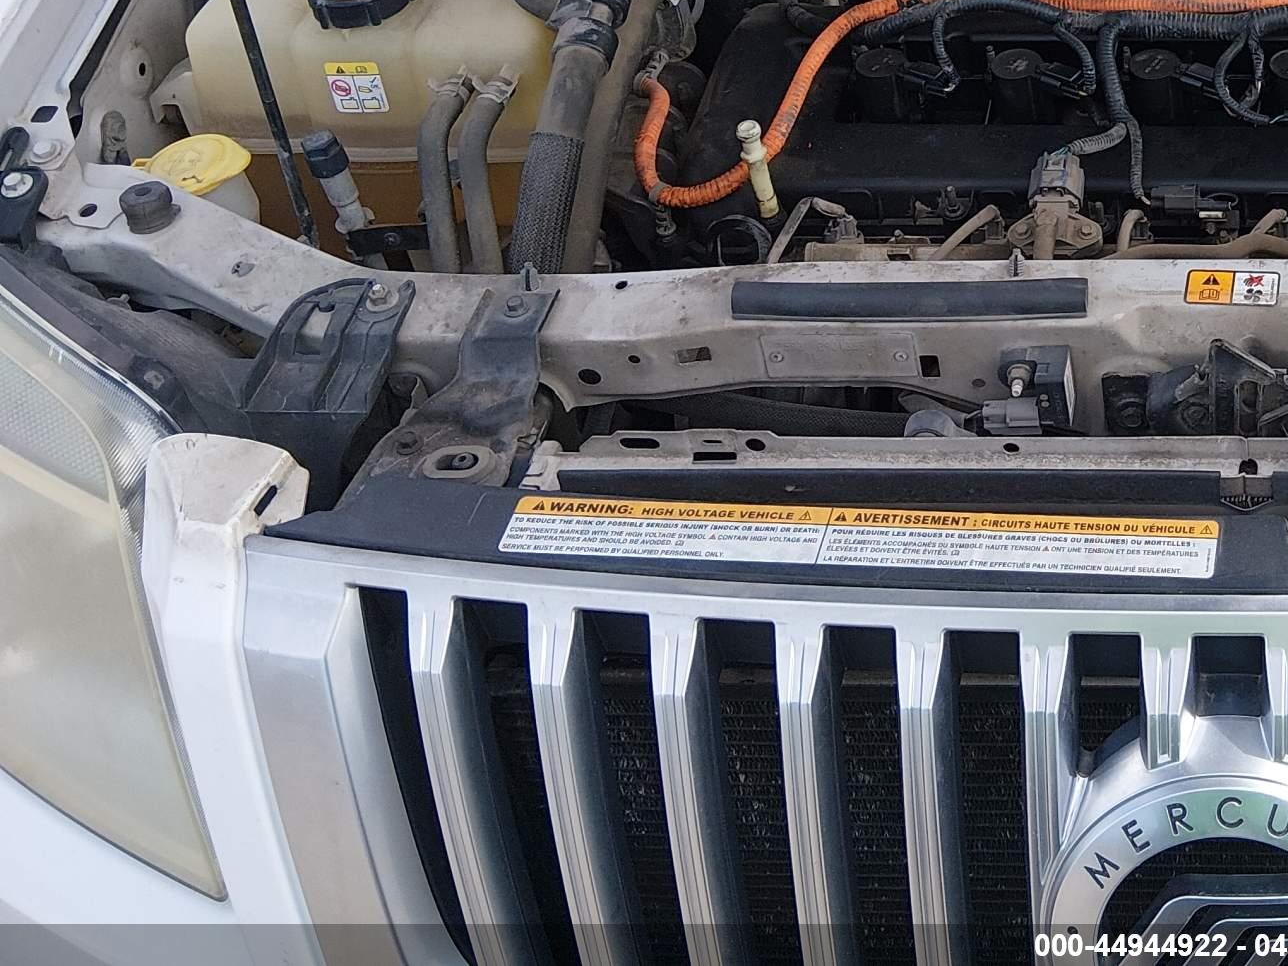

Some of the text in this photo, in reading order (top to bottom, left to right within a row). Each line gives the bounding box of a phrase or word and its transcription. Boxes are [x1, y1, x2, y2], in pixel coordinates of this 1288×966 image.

[550, 501, 794, 520] WARNING: HIGH VOLTAGE VEHICLE
[853, 513, 970, 526] AVERTISSEMENT
[981, 519, 1031, 529] CIRCUITS
[1034, 521, 1071, 530] HAUTE
[1073, 522, 1120, 532] TENSION
[1124, 524, 1138, 532] DU
[1142, 523, 1195, 534] VÉHICULE
